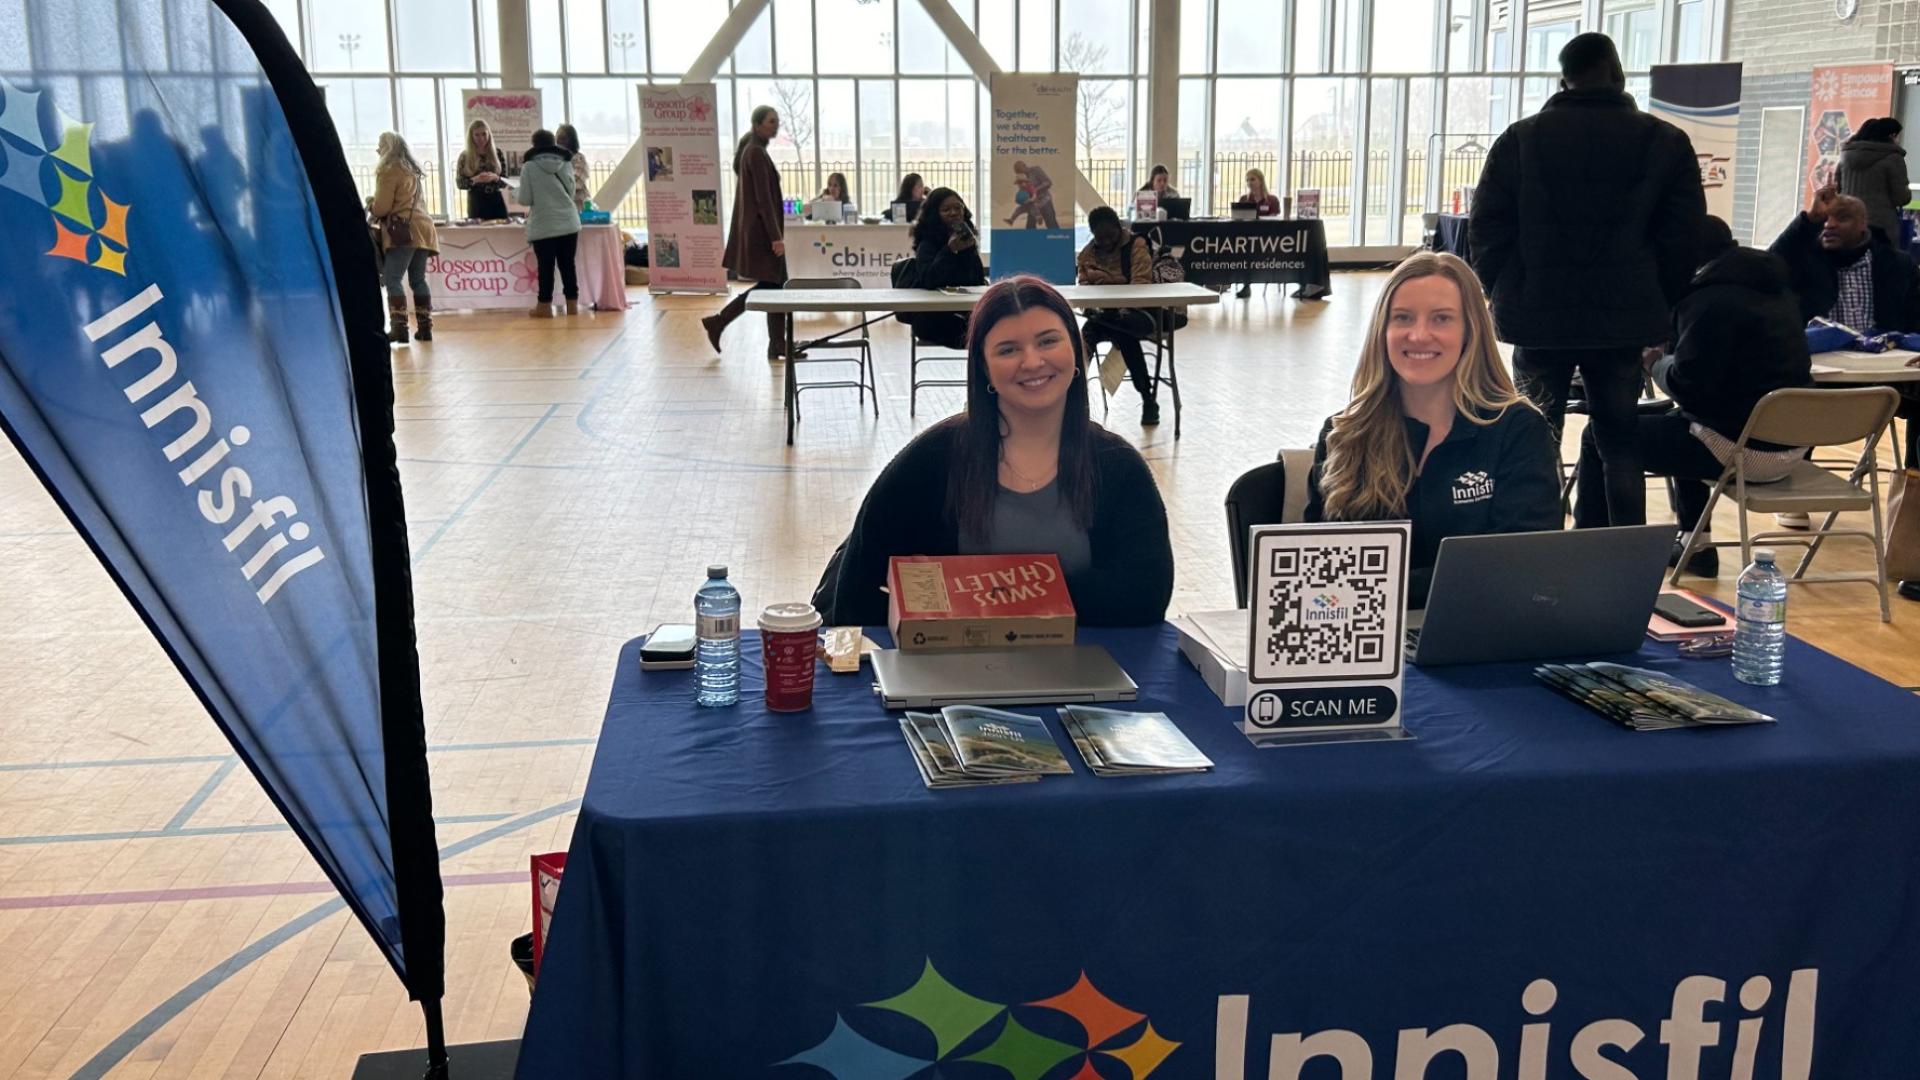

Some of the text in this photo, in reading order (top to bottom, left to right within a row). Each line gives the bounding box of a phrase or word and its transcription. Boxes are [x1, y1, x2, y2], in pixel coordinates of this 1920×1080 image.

[643, 96, 686, 109] Blossom
[654, 108, 687, 121] Group
[996, 109, 1039, 120] Together,
[1012, 122, 1040, 133] shape
[997, 134, 1046, 142] healthcare
[997, 145, 1060, 154] for the better.
[426, 255, 506, 273] Blossom
[832, 246, 865, 267] cbi
[1190, 258, 1305, 270] retirement residences
[445, 272, 508, 296] Group
[83, 283, 325, 605] Innisfil
[1452, 478, 1496, 500] Innisfi
[953, 560, 1057, 594] CHALET
[972, 580, 1048, 608] SWISS
[1305, 606, 1348, 621] Innisfil
[1290, 698, 1377, 717] SCAN ME
